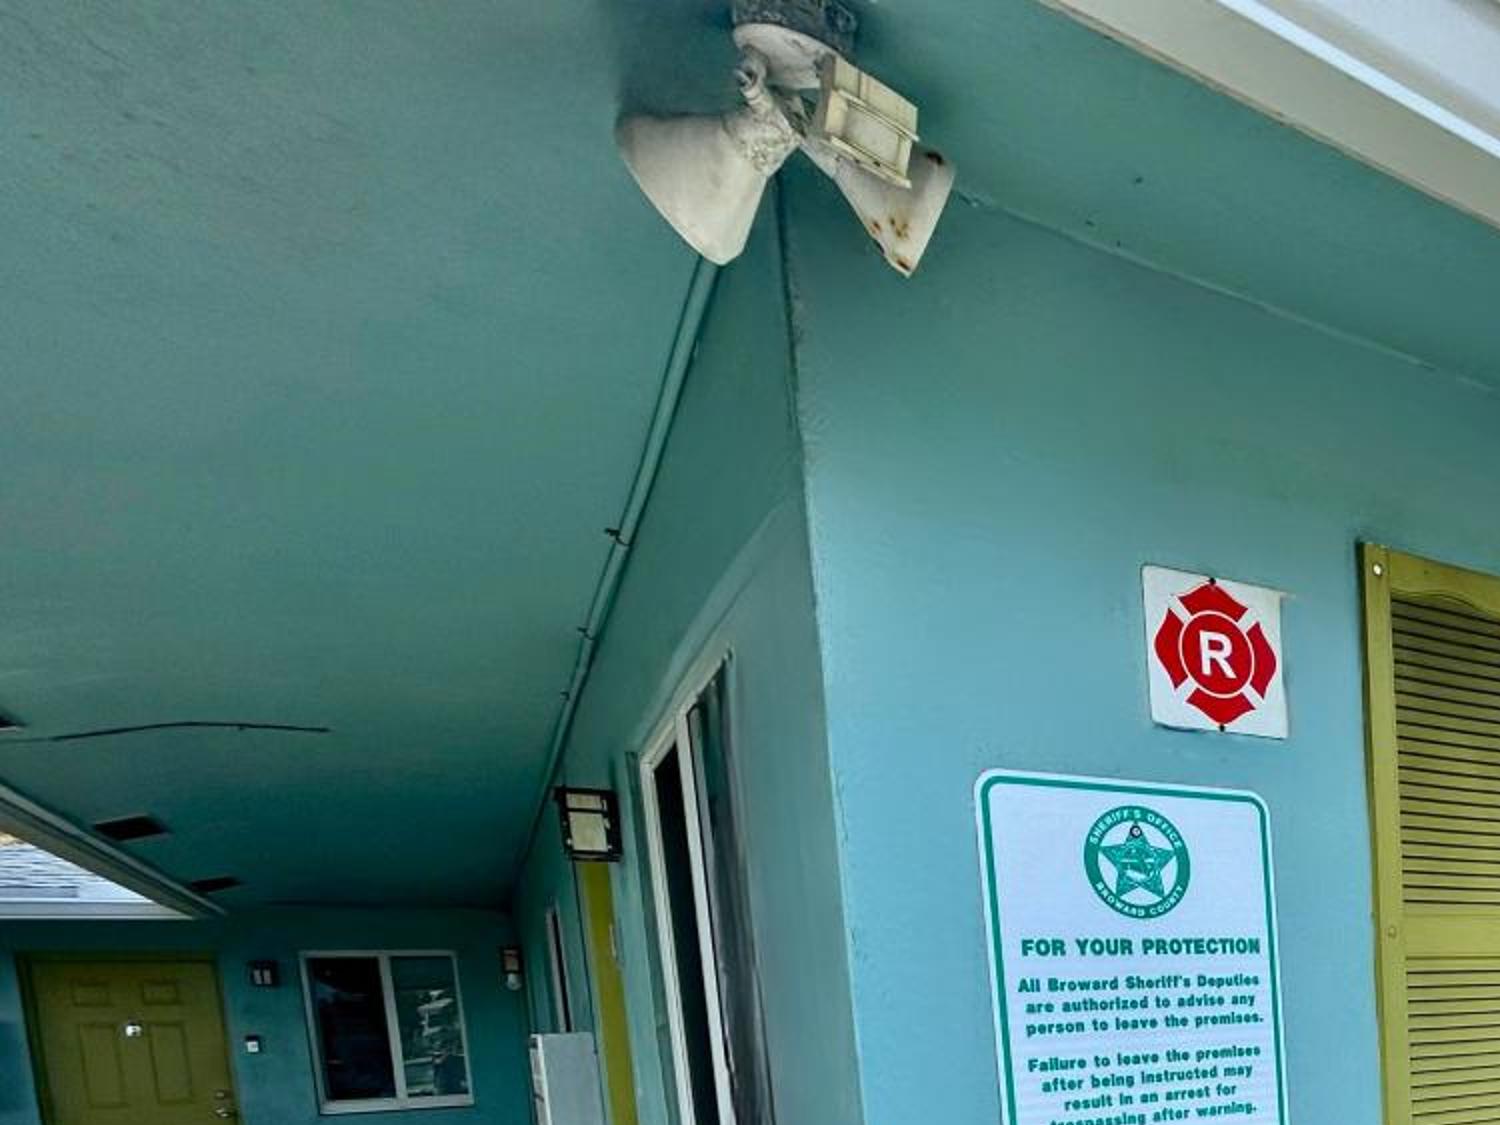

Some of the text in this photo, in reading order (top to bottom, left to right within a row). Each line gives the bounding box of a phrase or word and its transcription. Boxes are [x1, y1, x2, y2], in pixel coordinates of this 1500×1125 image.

[1200, 629, 1237, 679] R
[1147, 812, 1183, 849] OFFICE
[1096, 881, 1183, 917] BROWARD COUNTY
[1021, 937, 1260, 956] FOR YOUR PROTECTION
[1018, 973, 1259, 993] All Broward Sheriff's Deputies
[1025, 993, 1255, 1013] are authorized to advise any
[1025, 1011, 1264, 1037] person to leave the premises.
[1028, 1045, 1260, 1072] Failure to leave the premises
[1042, 1065, 1253, 1093] after being instructed may
[1064, 1083, 1237, 1111] result in an arrest for
[1153, 1107, 1190, 1122] after
[1195, 1101, 1257, 1116] warning.
